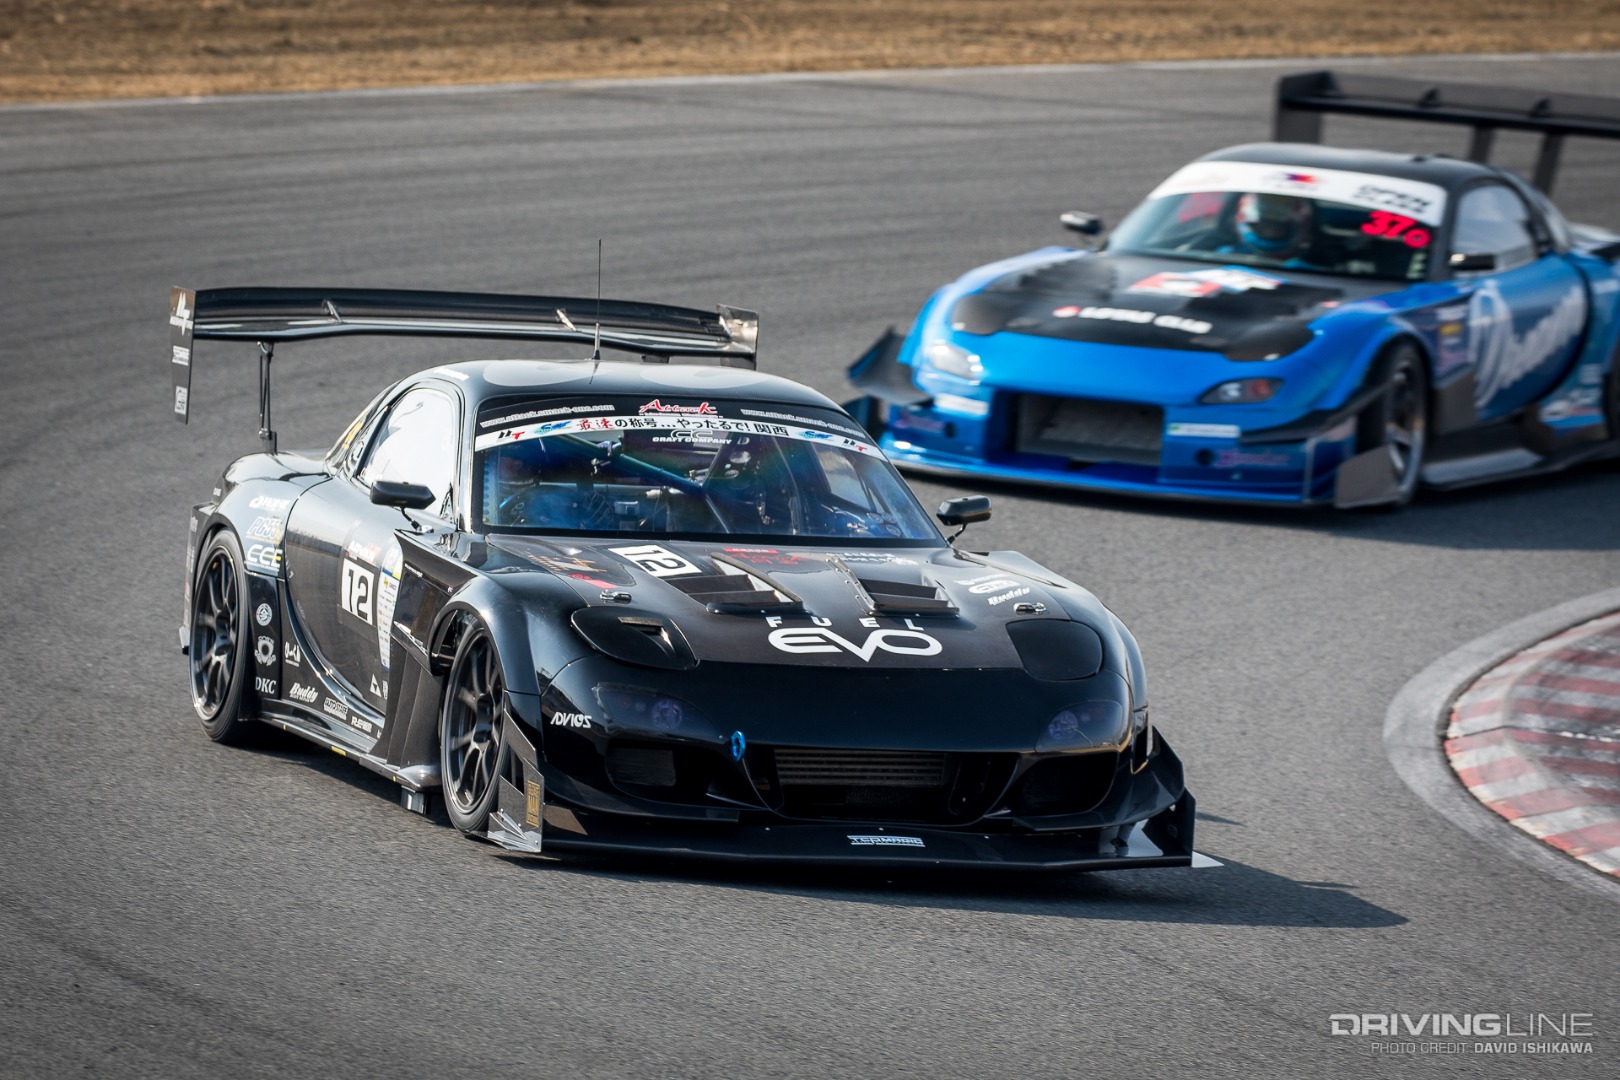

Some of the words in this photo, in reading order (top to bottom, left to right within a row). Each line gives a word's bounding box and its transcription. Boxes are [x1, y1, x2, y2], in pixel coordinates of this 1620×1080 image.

[639, 399, 718, 415] Attack
[687, 437, 732, 445] COMPANY
[348, 569, 369, 621] 12
[766, 616, 926, 631] FUEL
[767, 628, 943, 662] EVO
[255, 676, 277, 694] DKC
[289, 682, 319, 703] Buddy
